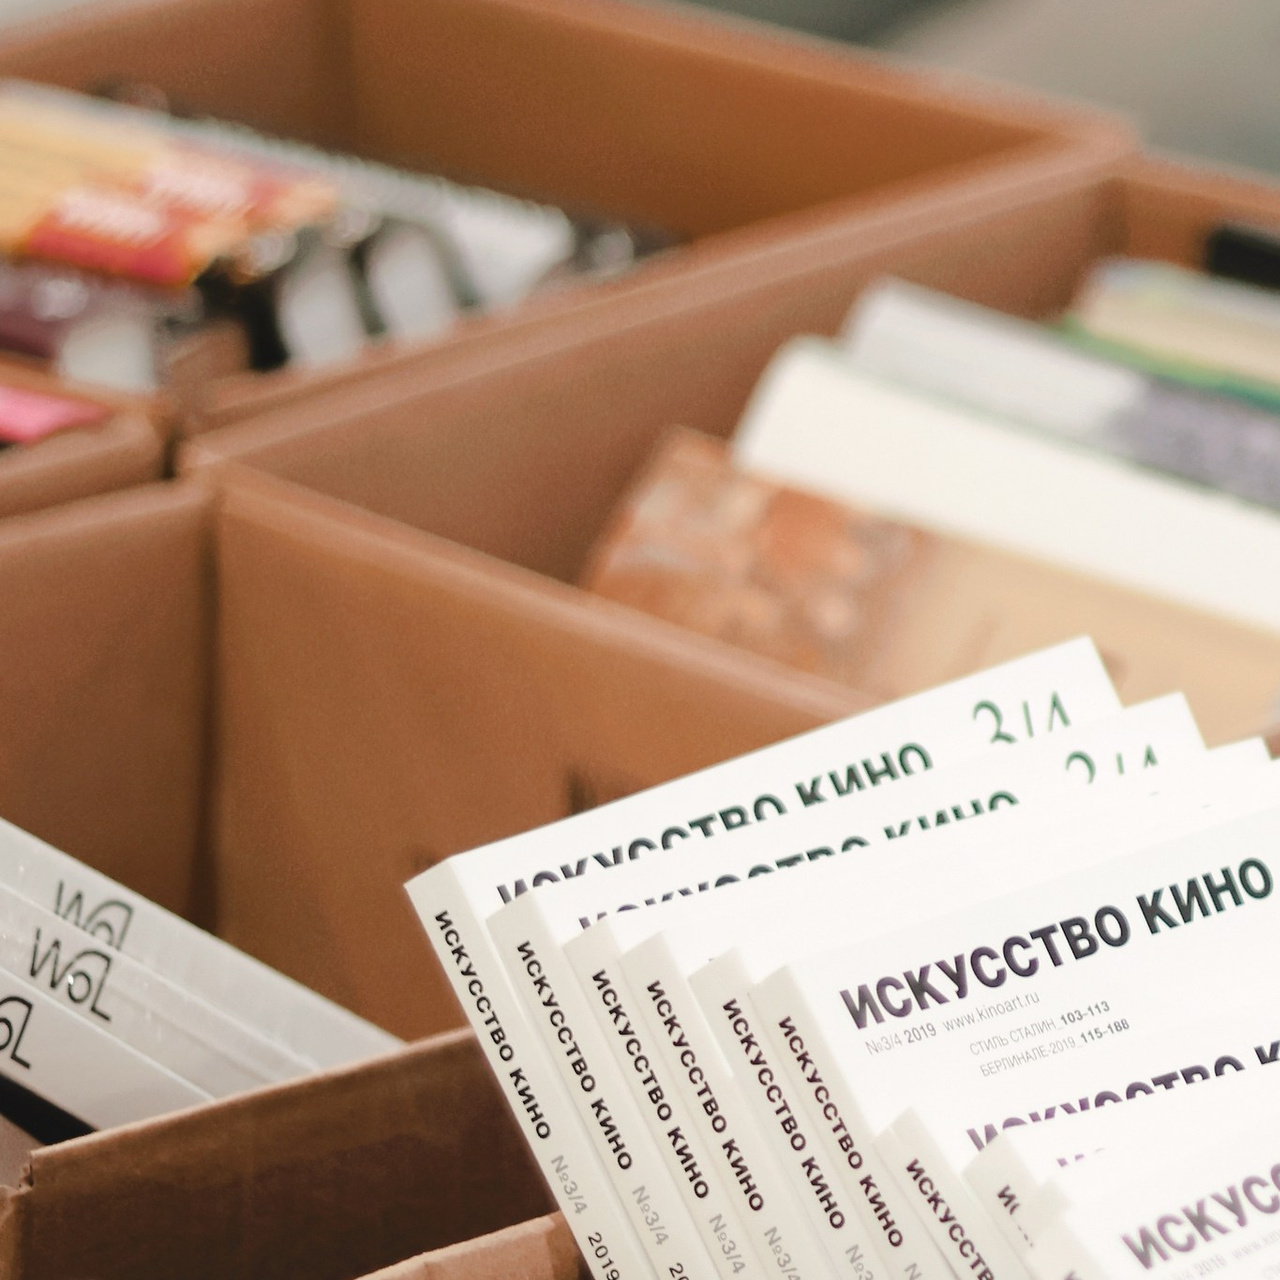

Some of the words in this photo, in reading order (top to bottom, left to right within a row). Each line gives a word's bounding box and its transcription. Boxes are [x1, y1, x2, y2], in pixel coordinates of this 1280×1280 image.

[435, 911, 514, 1061] ИСКУССТВО
[509, 1068, 550, 1139] КИНО
[517, 941, 595, 1092] ИСКУССТВО
[591, 1098, 632, 1170] КИНО
[840, 905, 1130, 1030] ИСКУССТВО
[1136, 858, 1273, 935] КИНО
[904, 1023, 936, 1044] 2019
[942, 992, 1040, 1032] www.kinoart.ru
[970, 1034, 1009, 1055] СТИЛЬ
[592, 970, 672, 1121] ИСКУССТВО
[667, 1126, 709, 1199] КИНО
[647, 981, 726, 1133] ИСКУССТВО
[722, 1139, 764, 1211] КИНО
[723, 999, 806, 1151] ИСКУССТВО
[801, 1157, 845, 1229] КИНО
[779, 1016, 863, 1169] ИСКУССТВО
[859, 1175, 903, 1247] КИНО
